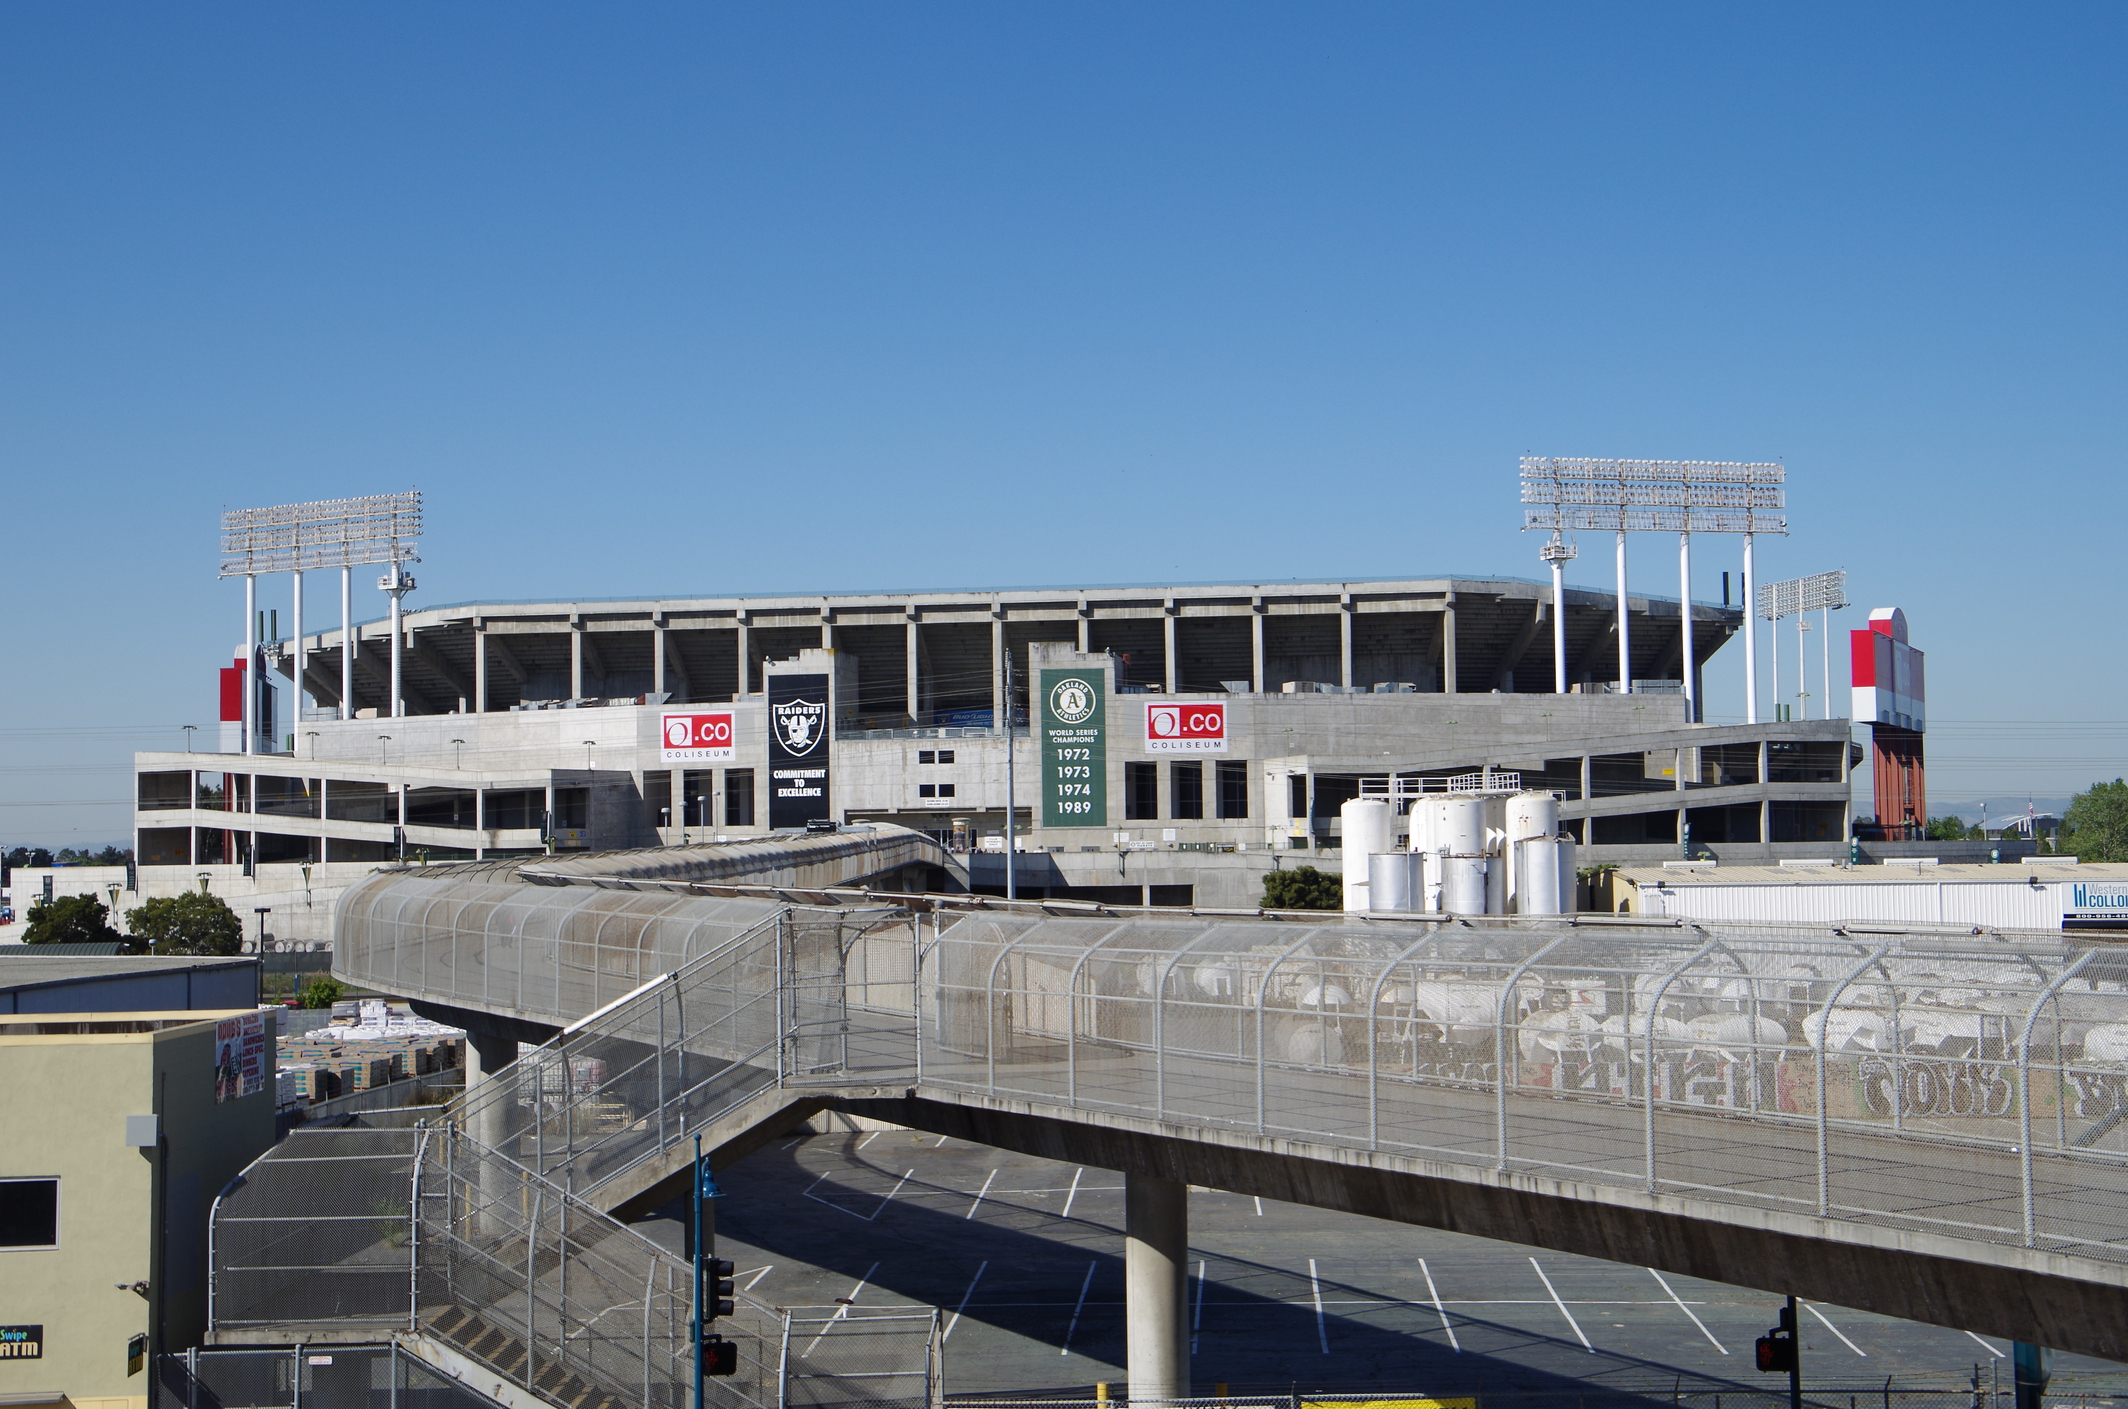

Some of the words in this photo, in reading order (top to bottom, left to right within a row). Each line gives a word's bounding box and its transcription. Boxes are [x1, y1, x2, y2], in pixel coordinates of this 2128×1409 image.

[1057, 682, 1089, 694] OAKLAND
[778, 706, 821, 715] RAIDERS
[1056, 707, 1090, 721] ATHLETICS
[1151, 741, 1221, 749] COLISEUM
[667, 750, 730, 758] COLISEUM
[1057, 748, 1090, 761] 1972
[773, 769, 826, 779] COMMITMENT
[1057, 765, 1091, 778] 1973
[793, 778, 805, 788] TO
[777, 787, 822, 797] EXCELLENCE
[1057, 783, 1091, 796] 1974
[1057, 801, 1092, 814] 1989
[2088, 884, 2128, 895] Western
[218, 1020, 241, 1040] DOUG'S
[0, 1328, 28, 1342] Swipe
[0, 1341, 39, 1357] ATM
